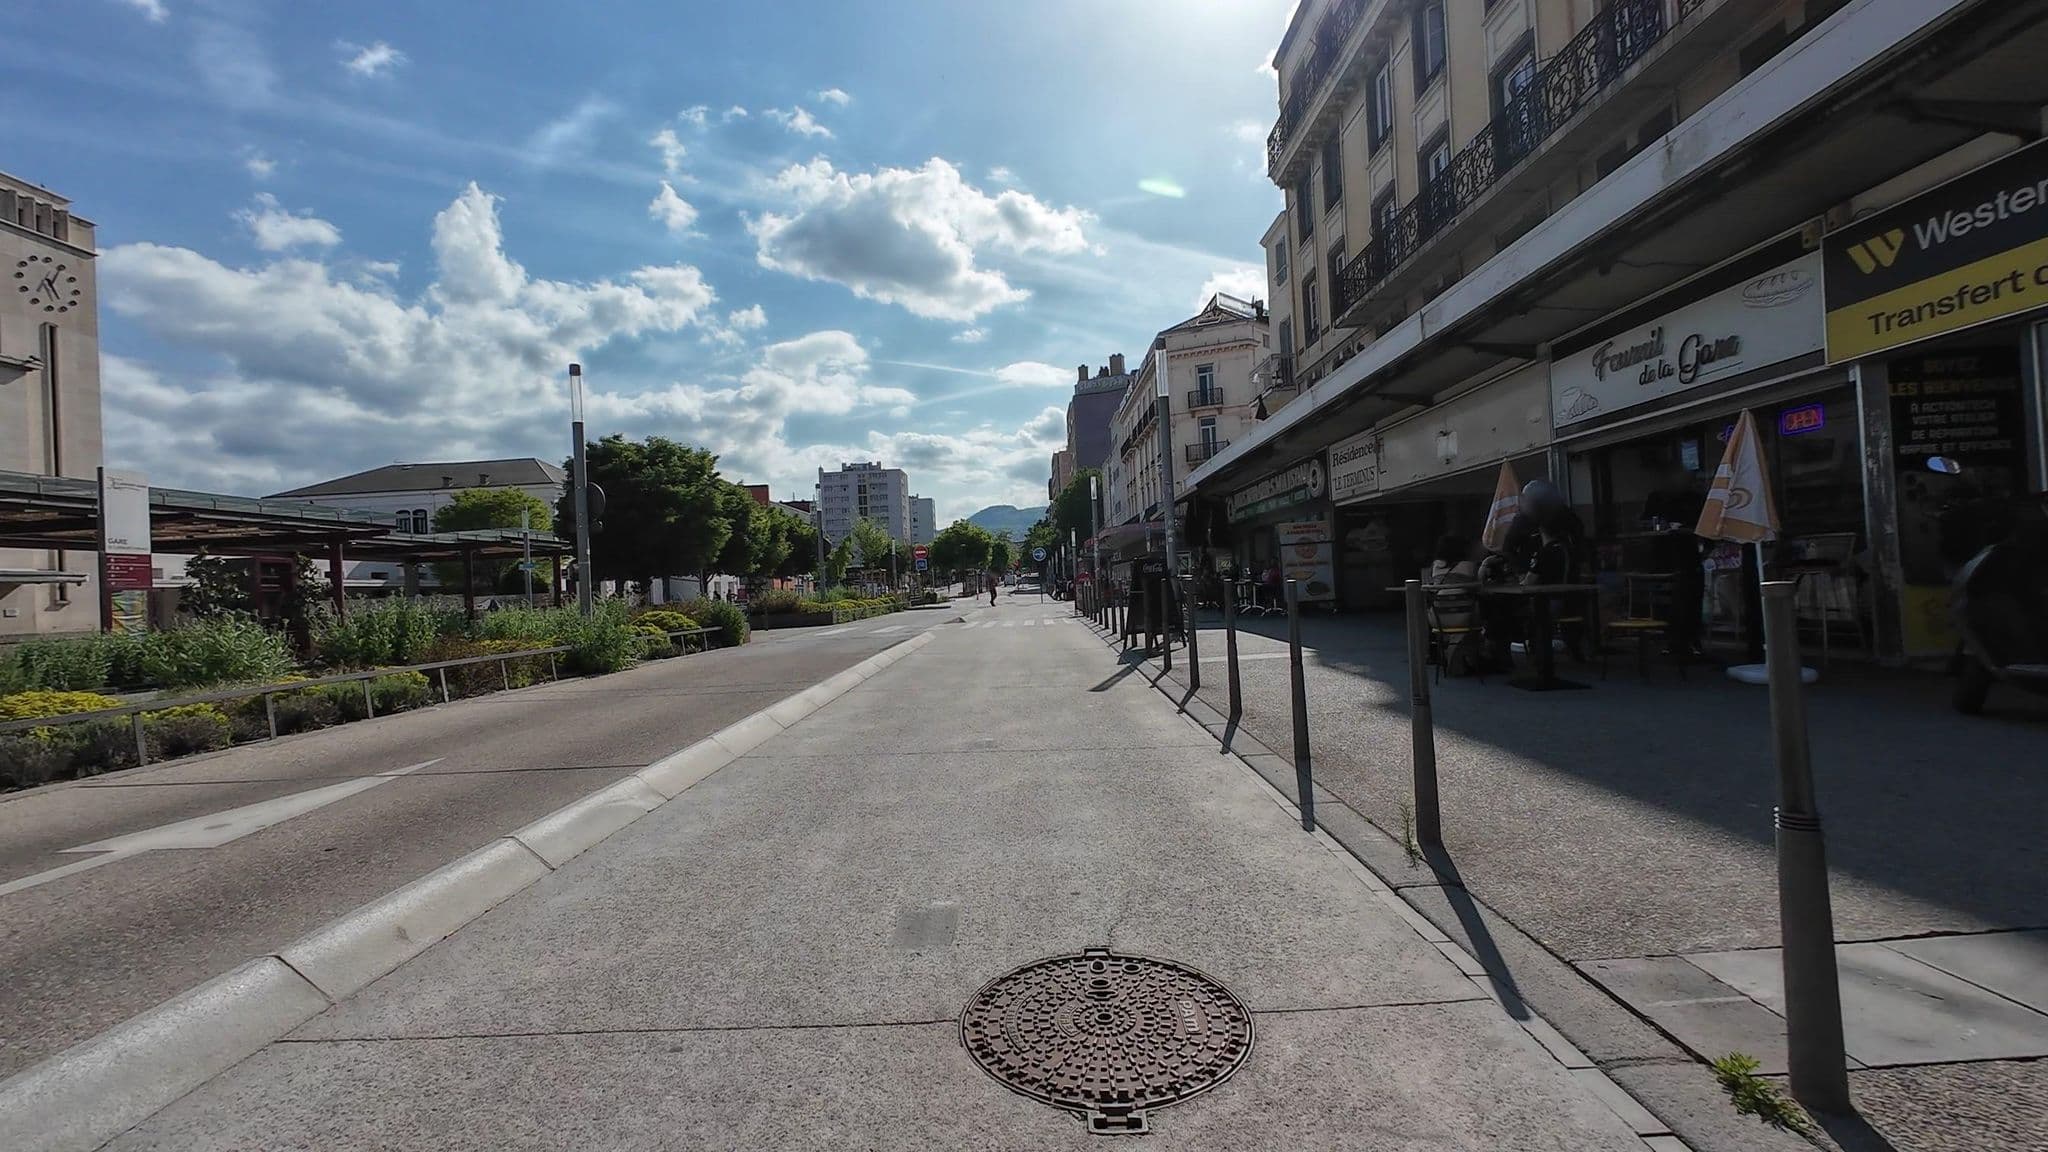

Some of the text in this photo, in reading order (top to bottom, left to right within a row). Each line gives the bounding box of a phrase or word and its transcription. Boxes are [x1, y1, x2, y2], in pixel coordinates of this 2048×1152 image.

[1867, 270, 2025, 335] Transfert
[1639, 333, 1741, 386] de la Gare
[1889, 382, 1918, 396] LES
[1784, 409, 1819, 430] OPEN
[1911, 429, 1926, 440] DE
[1332, 443, 1374, 467] Résidence
